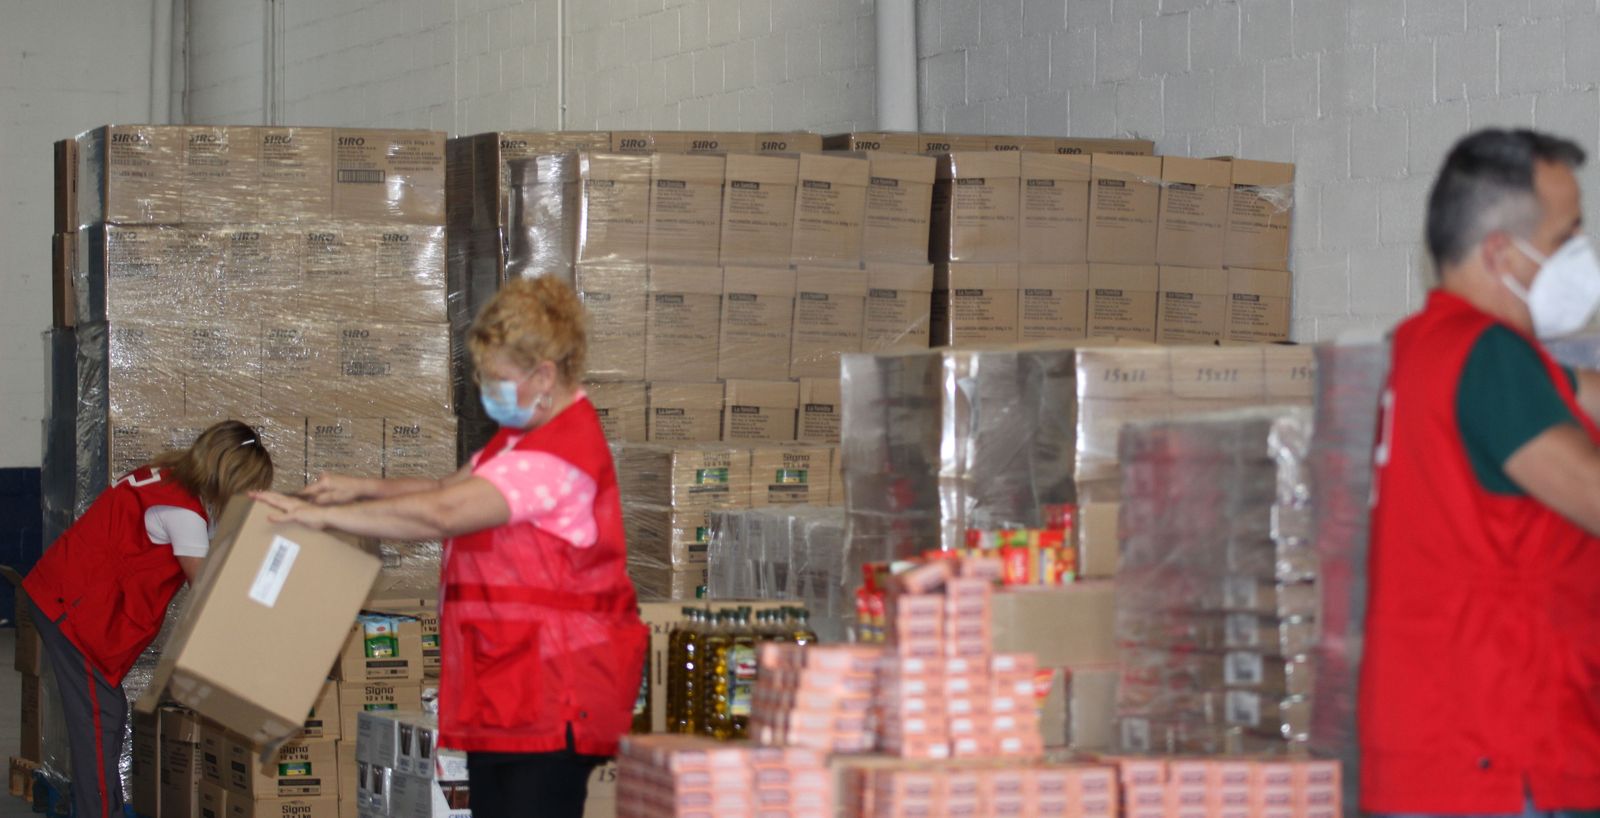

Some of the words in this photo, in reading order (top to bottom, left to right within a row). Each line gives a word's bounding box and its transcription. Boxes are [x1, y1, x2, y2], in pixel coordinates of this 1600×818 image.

[112, 133, 141, 143] SIRO
[263, 134, 292, 144] SIRO
[337, 136, 365, 146] SIRO
[500, 140, 528, 149] SIRO
[620, 139, 647, 148] SIRO
[692, 140, 718, 149] SIRO
[761, 142, 787, 150] SIRO
[855, 141, 881, 150] SIRO
[926, 142, 951, 150] SIRO
[342, 329, 370, 338] SIRO
[315, 425, 342, 434] SIRO
[393, 426, 420, 434] SIRO
[783, 453, 810, 462] Signo
[365, 686, 394, 696] Signo
[282, 804, 311, 814] Signo
